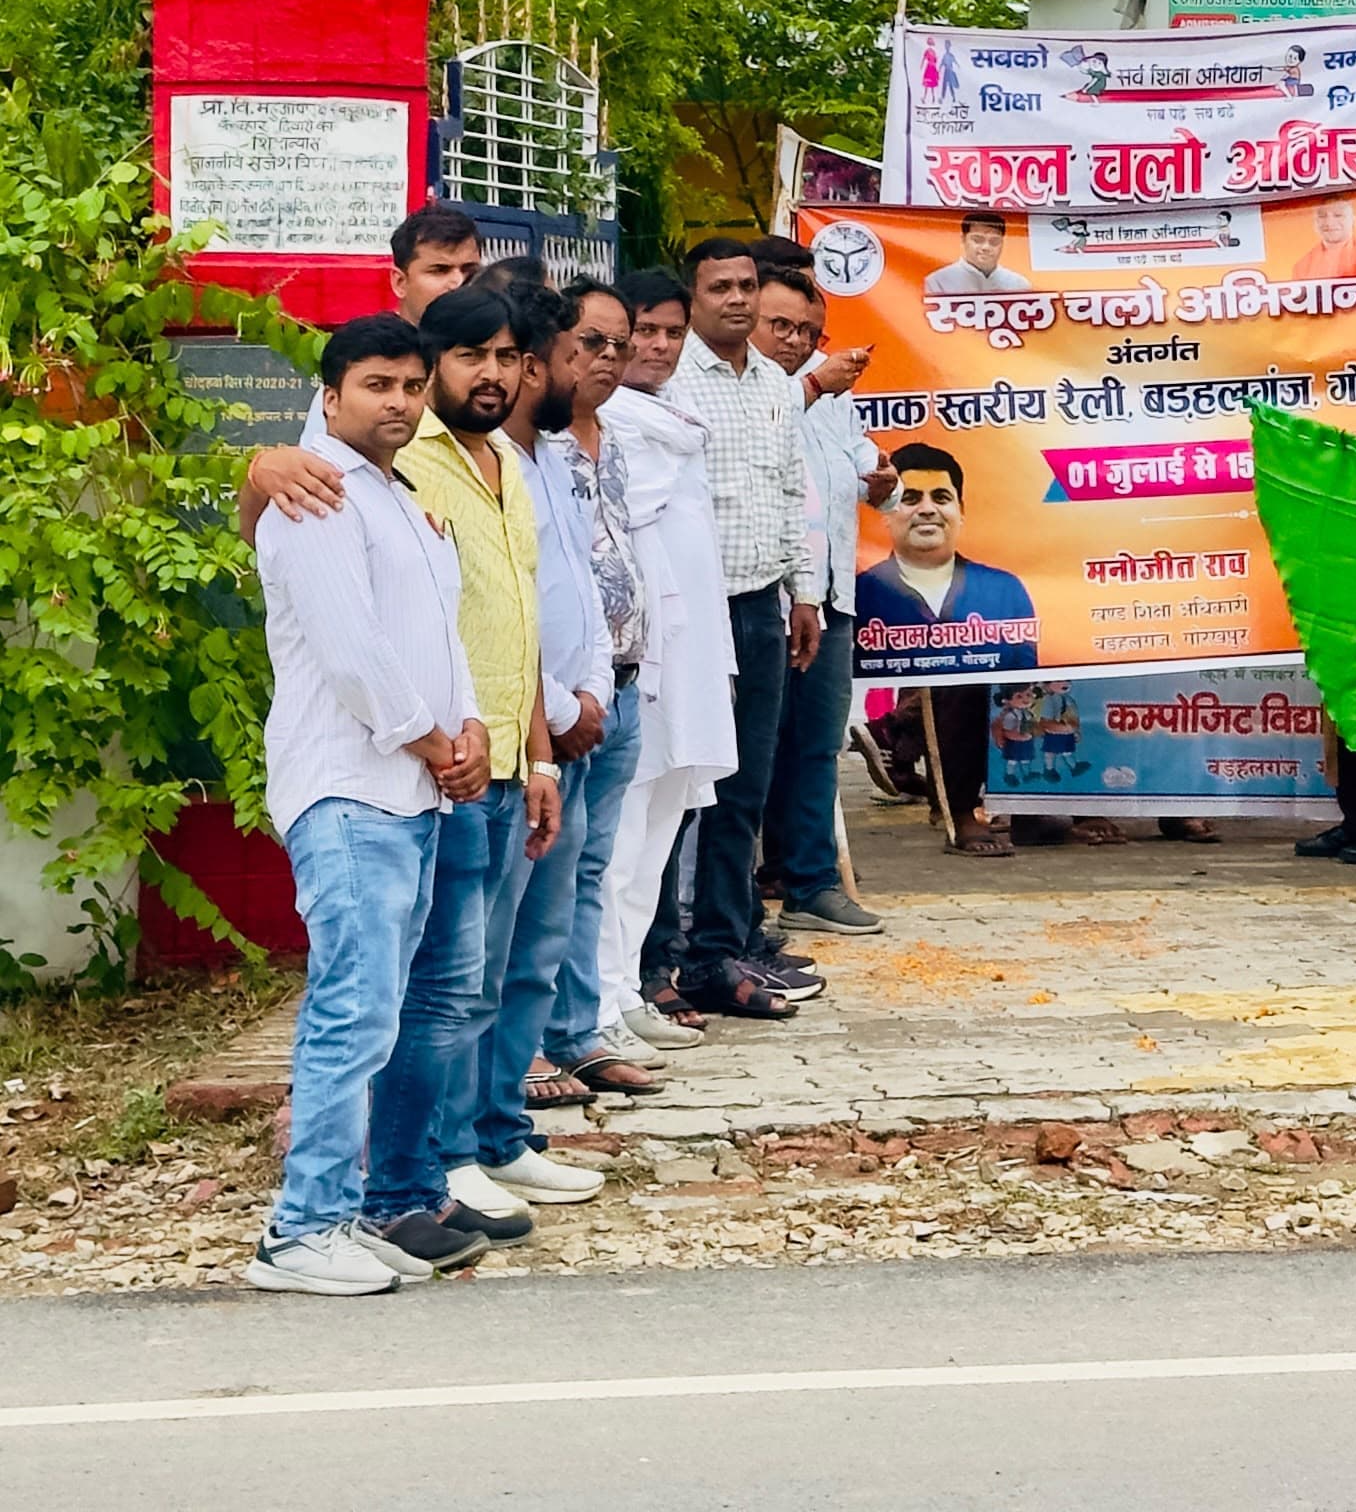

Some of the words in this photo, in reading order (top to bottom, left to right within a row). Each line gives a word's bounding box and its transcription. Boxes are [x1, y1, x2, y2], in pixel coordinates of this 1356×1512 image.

[971, 43, 1049, 69] सबको
[1116, 64, 1144, 86] सर्व
[1196, 62, 1264, 86] अभियान
[979, 83, 1042, 112] शिक्षा
[925, 144, 1074, 208] स्कूल
[1091, 129, 1207, 199] चलो
[924, 289, 1056, 348] स्कूल
[1063, 275, 1168, 327] चलो
[1106, 336, 1200, 364] अंतर्गत
[255, 377, 302, 389] 2020-21
[853, 393, 929, 430] लाक
[935, 377, 1047, 430] स्तरीय
[1067, 460, 1097, 489] 01
[1104, 448, 1186, 493] जुलाई
[1192, 448, 1217, 482] से
[1084, 550, 1197, 584] मनोजीत
[1202, 550, 1249, 579] राव
[858, 618, 886, 650] श्री
[888, 625, 927, 650] राम
[929, 612, 1000, 648] आशीष
[1001, 618, 1041, 644] राय
[1106, 691, 1257, 735] कम्पोजिट
[1260, 691, 1324, 735] विद्या
